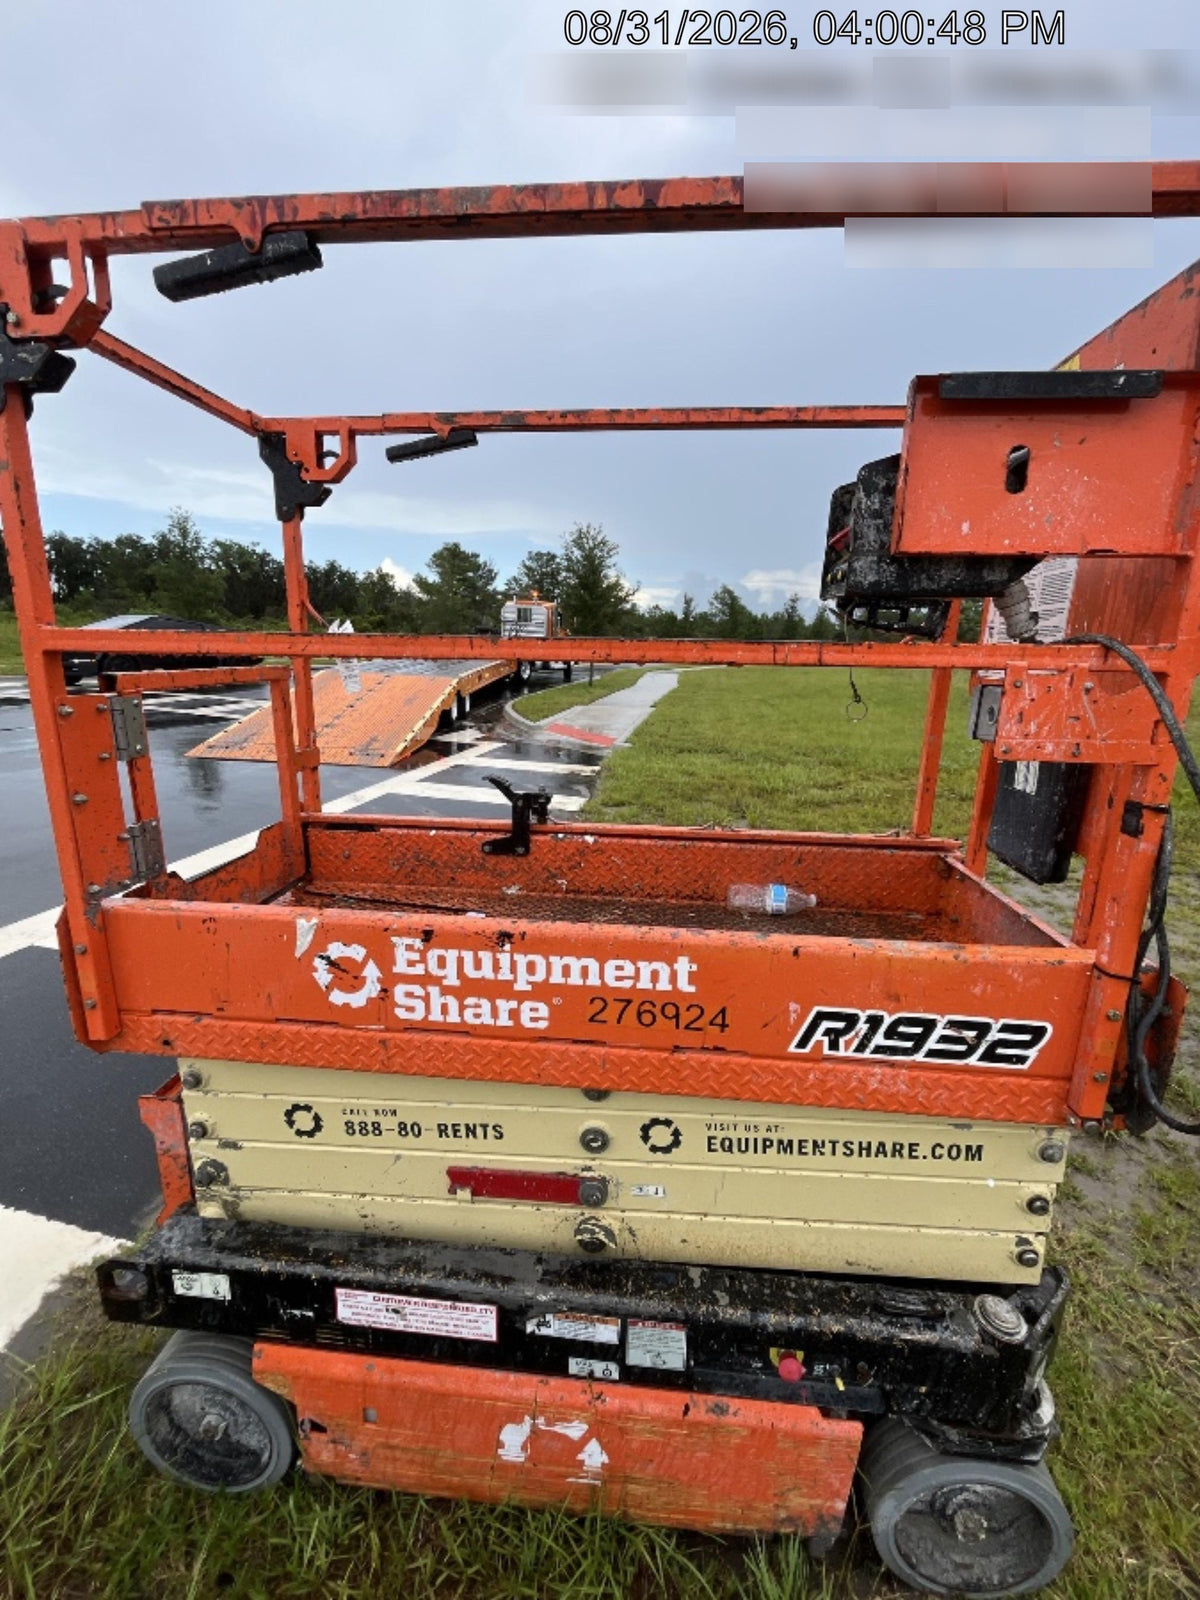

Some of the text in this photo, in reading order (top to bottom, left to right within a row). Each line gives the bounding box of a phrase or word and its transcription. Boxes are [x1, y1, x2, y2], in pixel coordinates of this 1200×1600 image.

[390, 936, 698, 992] Equipment
[588, 997, 730, 1034] 276924
[788, 1006, 1053, 1070] R1932
[344, 1120, 504, 1140] 888-80-RENTS
[705, 1122, 738, 1132] VISIT
[744, 1124, 760, 1133] US
[706, 1135, 985, 1162] EQUIPMENTSHARE.COM
